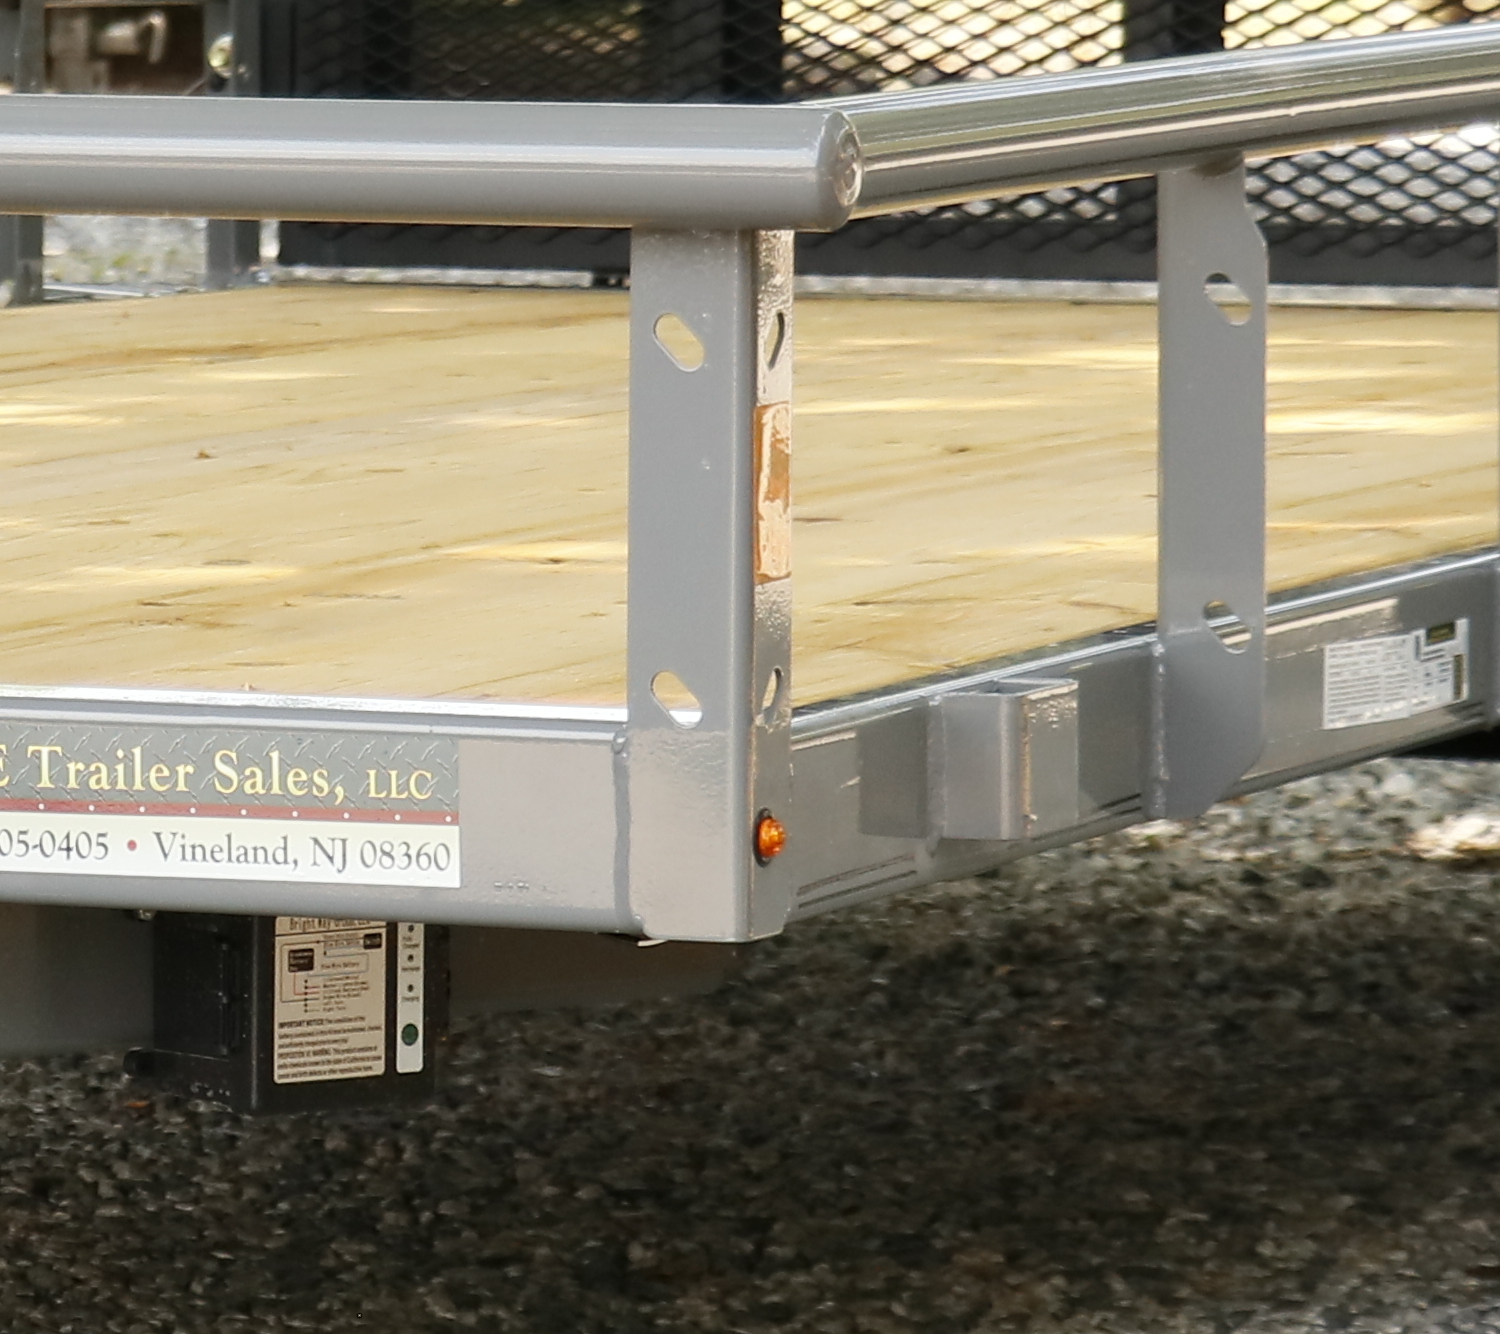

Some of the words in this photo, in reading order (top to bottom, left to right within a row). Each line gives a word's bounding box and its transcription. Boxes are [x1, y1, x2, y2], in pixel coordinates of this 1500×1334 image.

[26, 743, 195, 793] Trailer
[213, 748, 345, 805] Sales,
[366, 769, 435, 800] LLC
[152, 831, 300, 870] Vineland,
[310, 836, 348, 873] NJ
[358, 839, 451, 873] 08360
